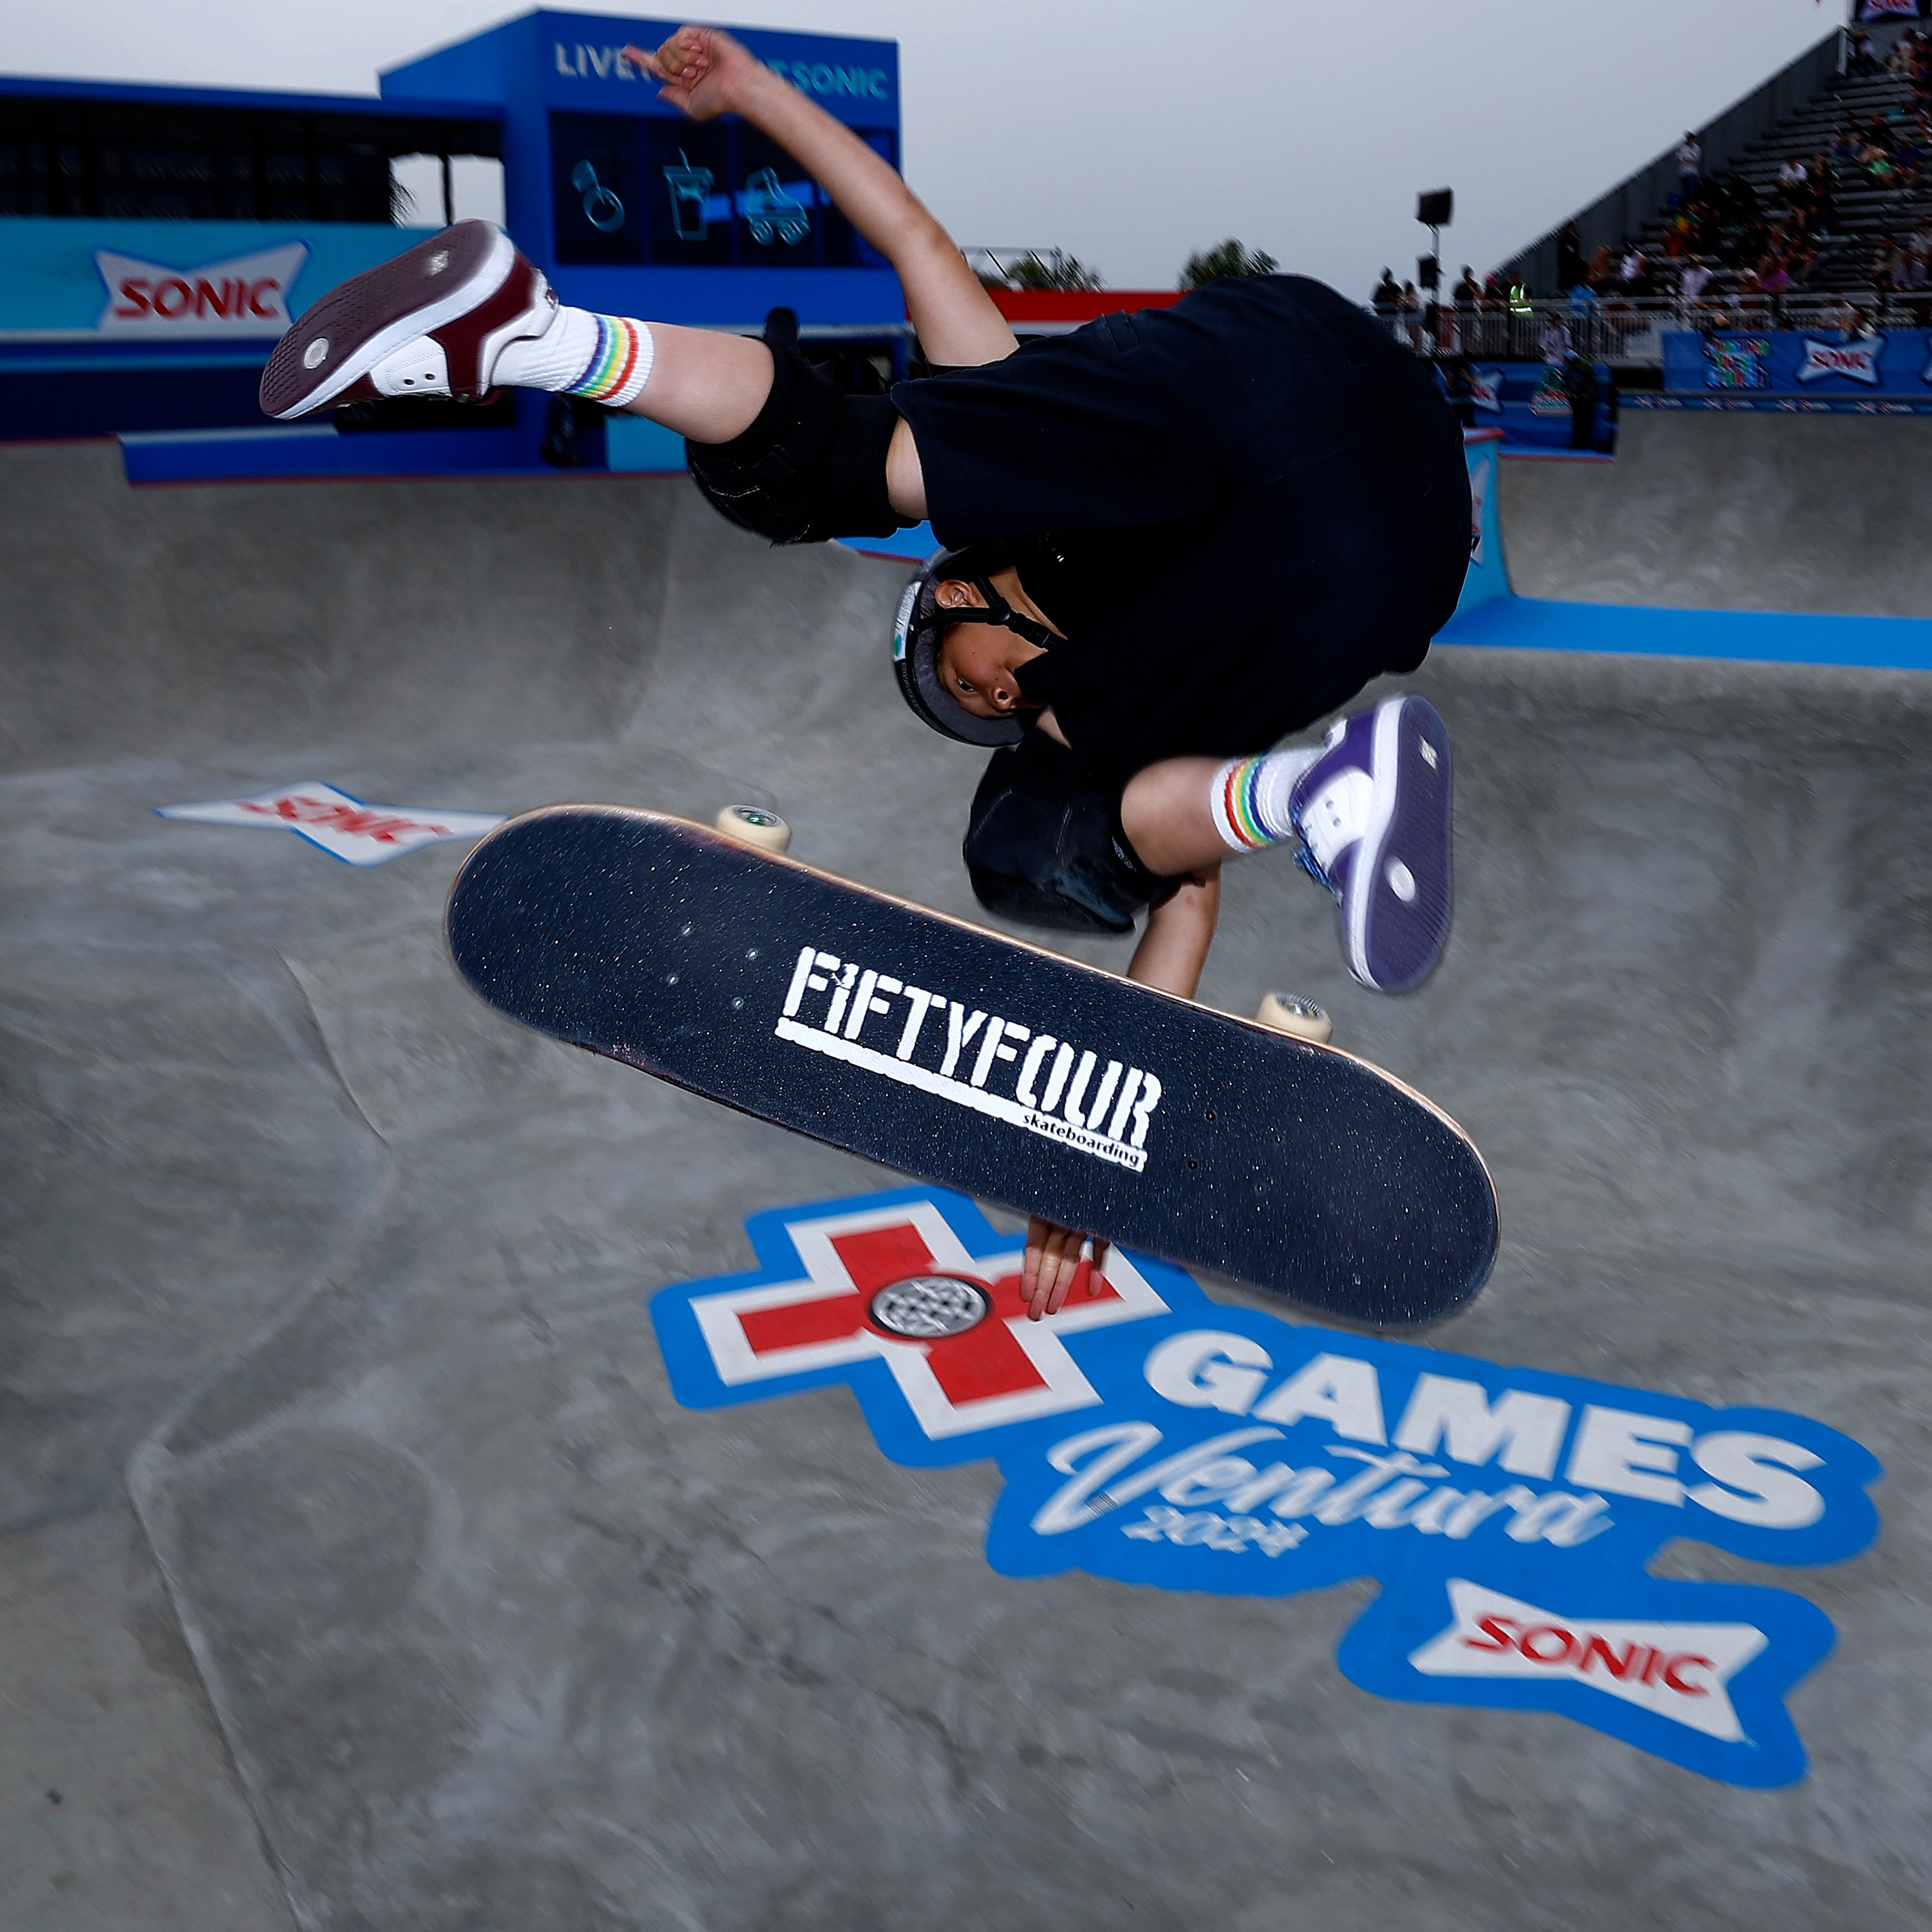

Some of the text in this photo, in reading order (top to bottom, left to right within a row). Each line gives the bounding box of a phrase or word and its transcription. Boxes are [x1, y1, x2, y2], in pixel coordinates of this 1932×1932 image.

[790, 61, 889, 100] SONIC
[115, 276, 281, 319] SONIC
[782, 946, 1162, 1149] FIFTYFOUR
[1022, 1113, 1141, 1168] skateboarding
[1143, 1329, 1827, 1530] GAMES
[1030, 1421, 1615, 1548] Ventura
[1121, 1506, 1310, 1558] 2024
[1460, 1611, 1720, 1698] SONIC
